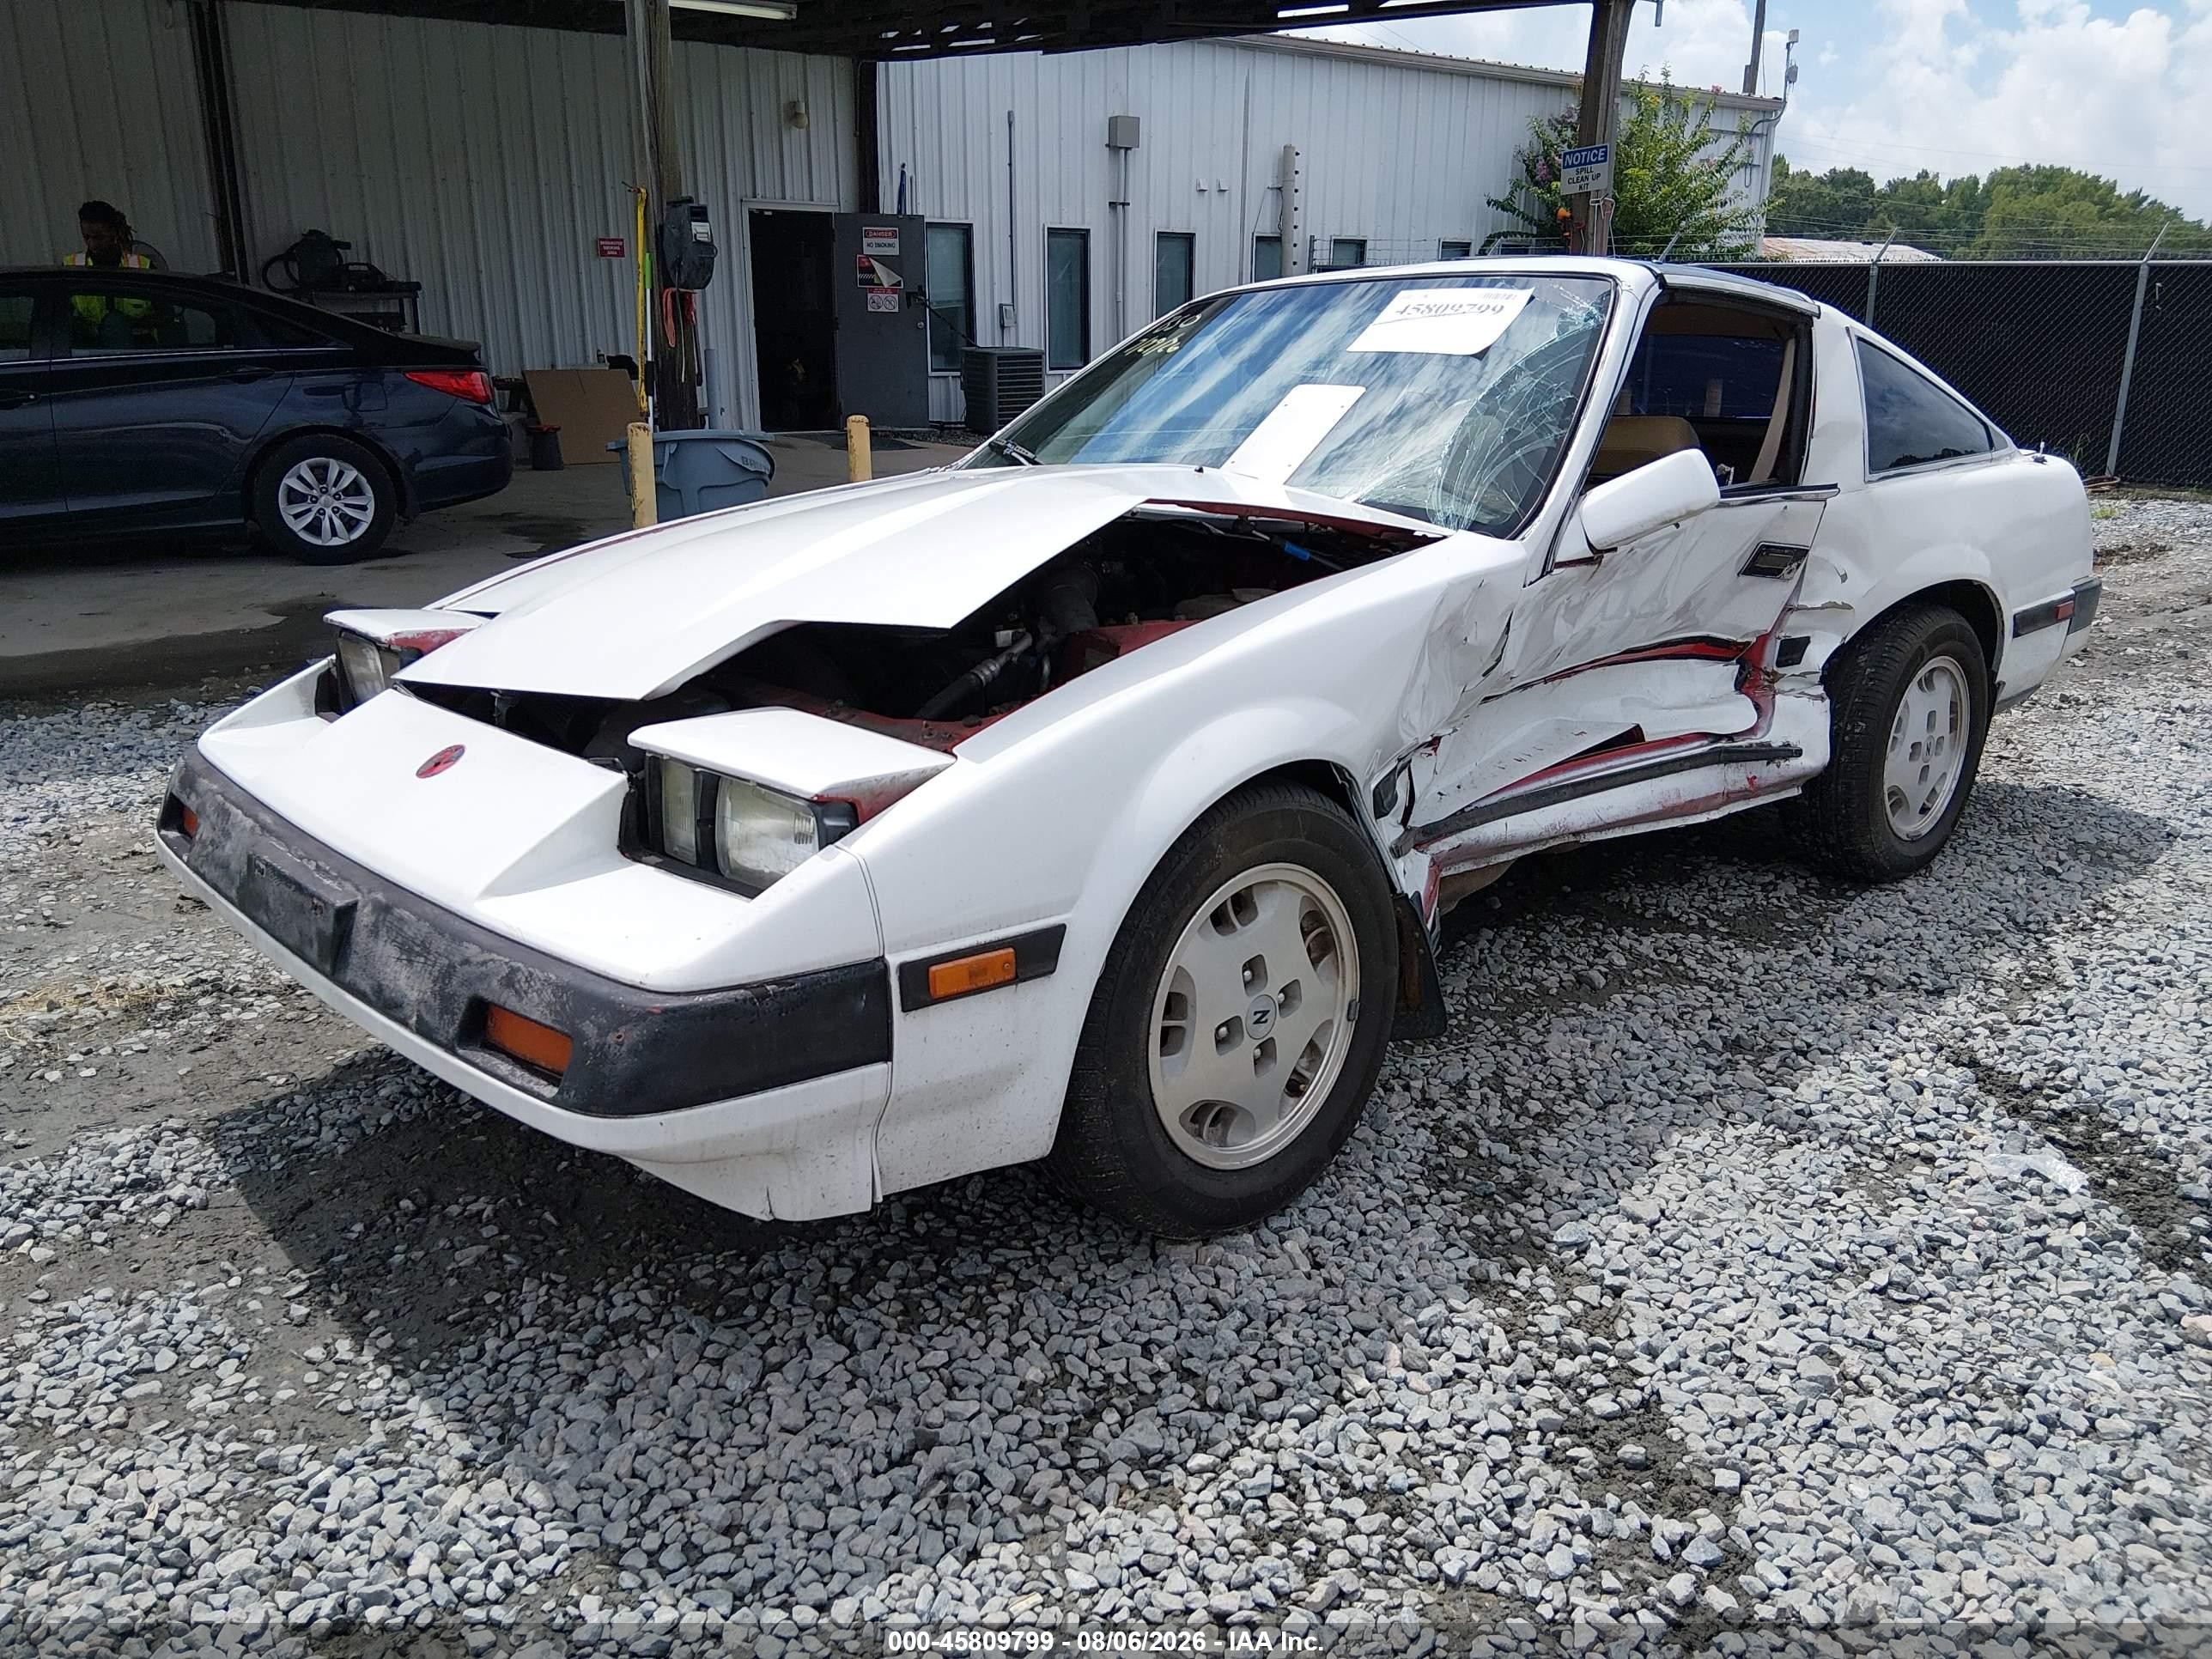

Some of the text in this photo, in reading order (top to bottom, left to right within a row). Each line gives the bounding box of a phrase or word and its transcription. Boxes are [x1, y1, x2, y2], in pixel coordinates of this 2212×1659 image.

[1565, 148, 1607, 167] NOTICE
[1575, 166, 1594, 176] SPILL
[1567, 173, 1601, 185] CLEAN UP
[1578, 183, 1589, 191] KIT
